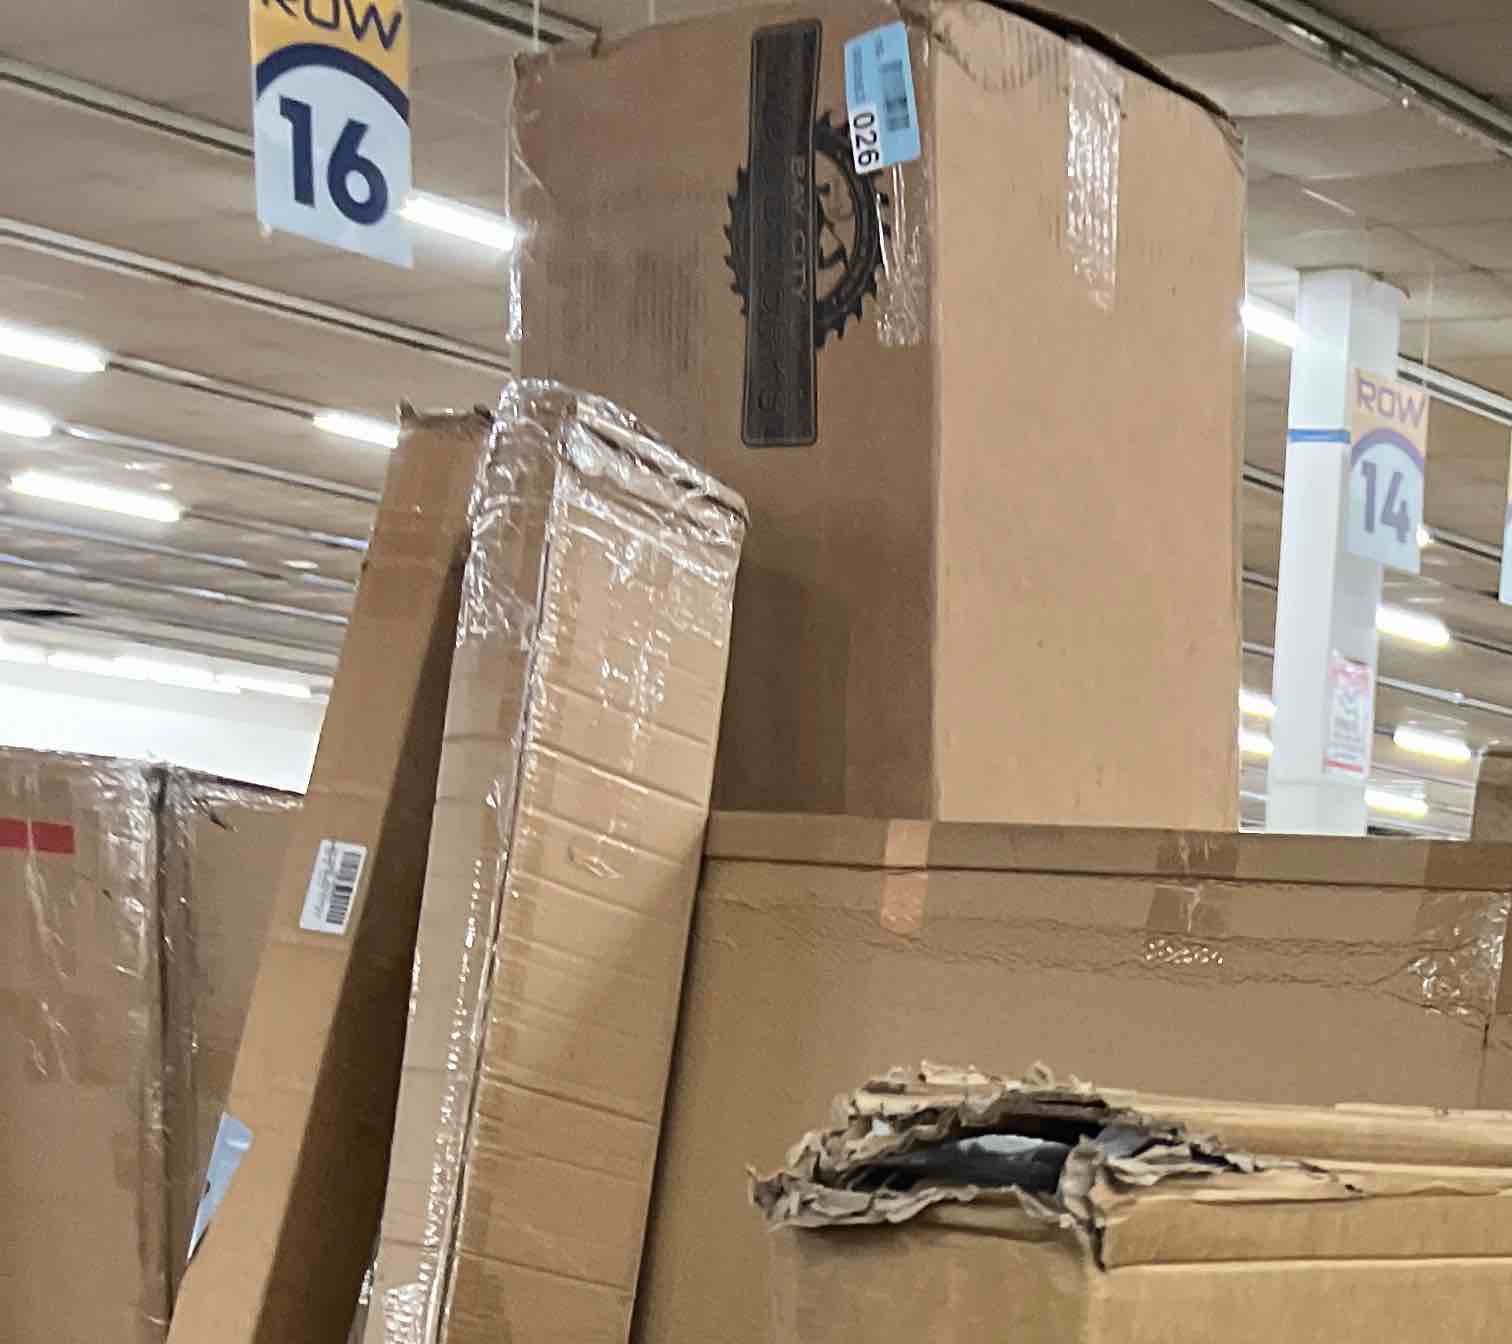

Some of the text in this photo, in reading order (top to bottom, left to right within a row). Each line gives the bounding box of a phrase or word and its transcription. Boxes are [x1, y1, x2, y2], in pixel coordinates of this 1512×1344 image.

[278, 95, 389, 225] 16
[853, 111, 879, 168] 026
[1356, 376, 1425, 428] ROW
[1360, 461, 1411, 544] 14
